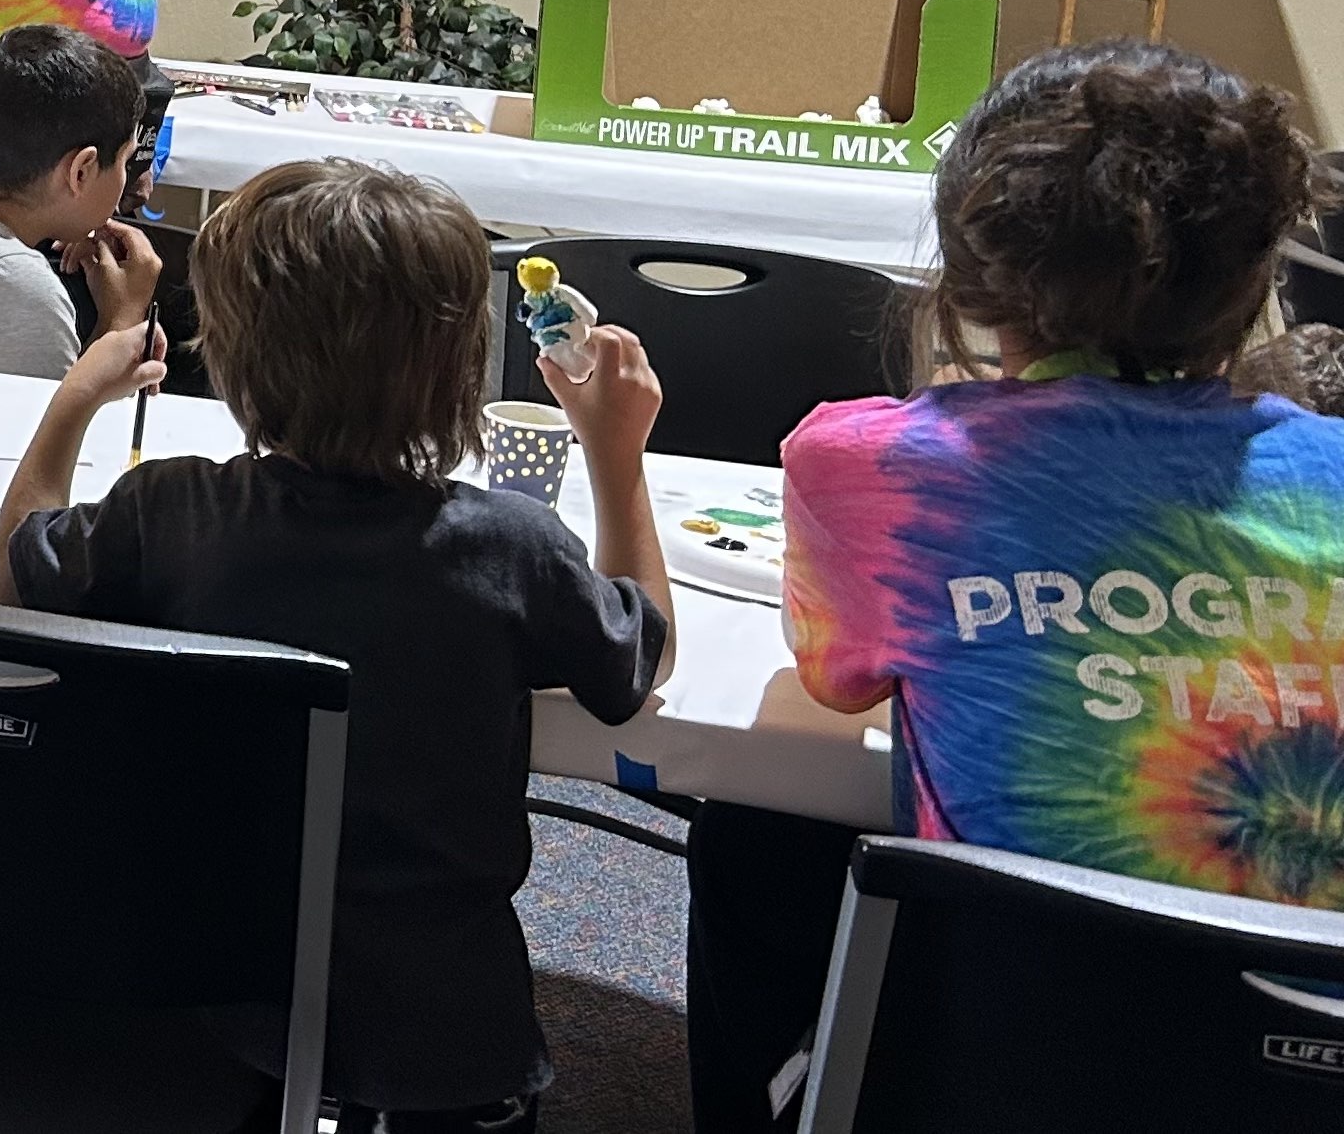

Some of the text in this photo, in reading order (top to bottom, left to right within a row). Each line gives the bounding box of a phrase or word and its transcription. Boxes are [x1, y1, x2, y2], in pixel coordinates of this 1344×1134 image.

[598, 117, 670, 148] POWER
[676, 122, 704, 149] UP
[708, 125, 819, 159] TRAIL
[832, 134, 910, 166] MIX
[1076, 652, 1344, 729] STAF
[1281, 1041, 1344, 1064] LIFE
